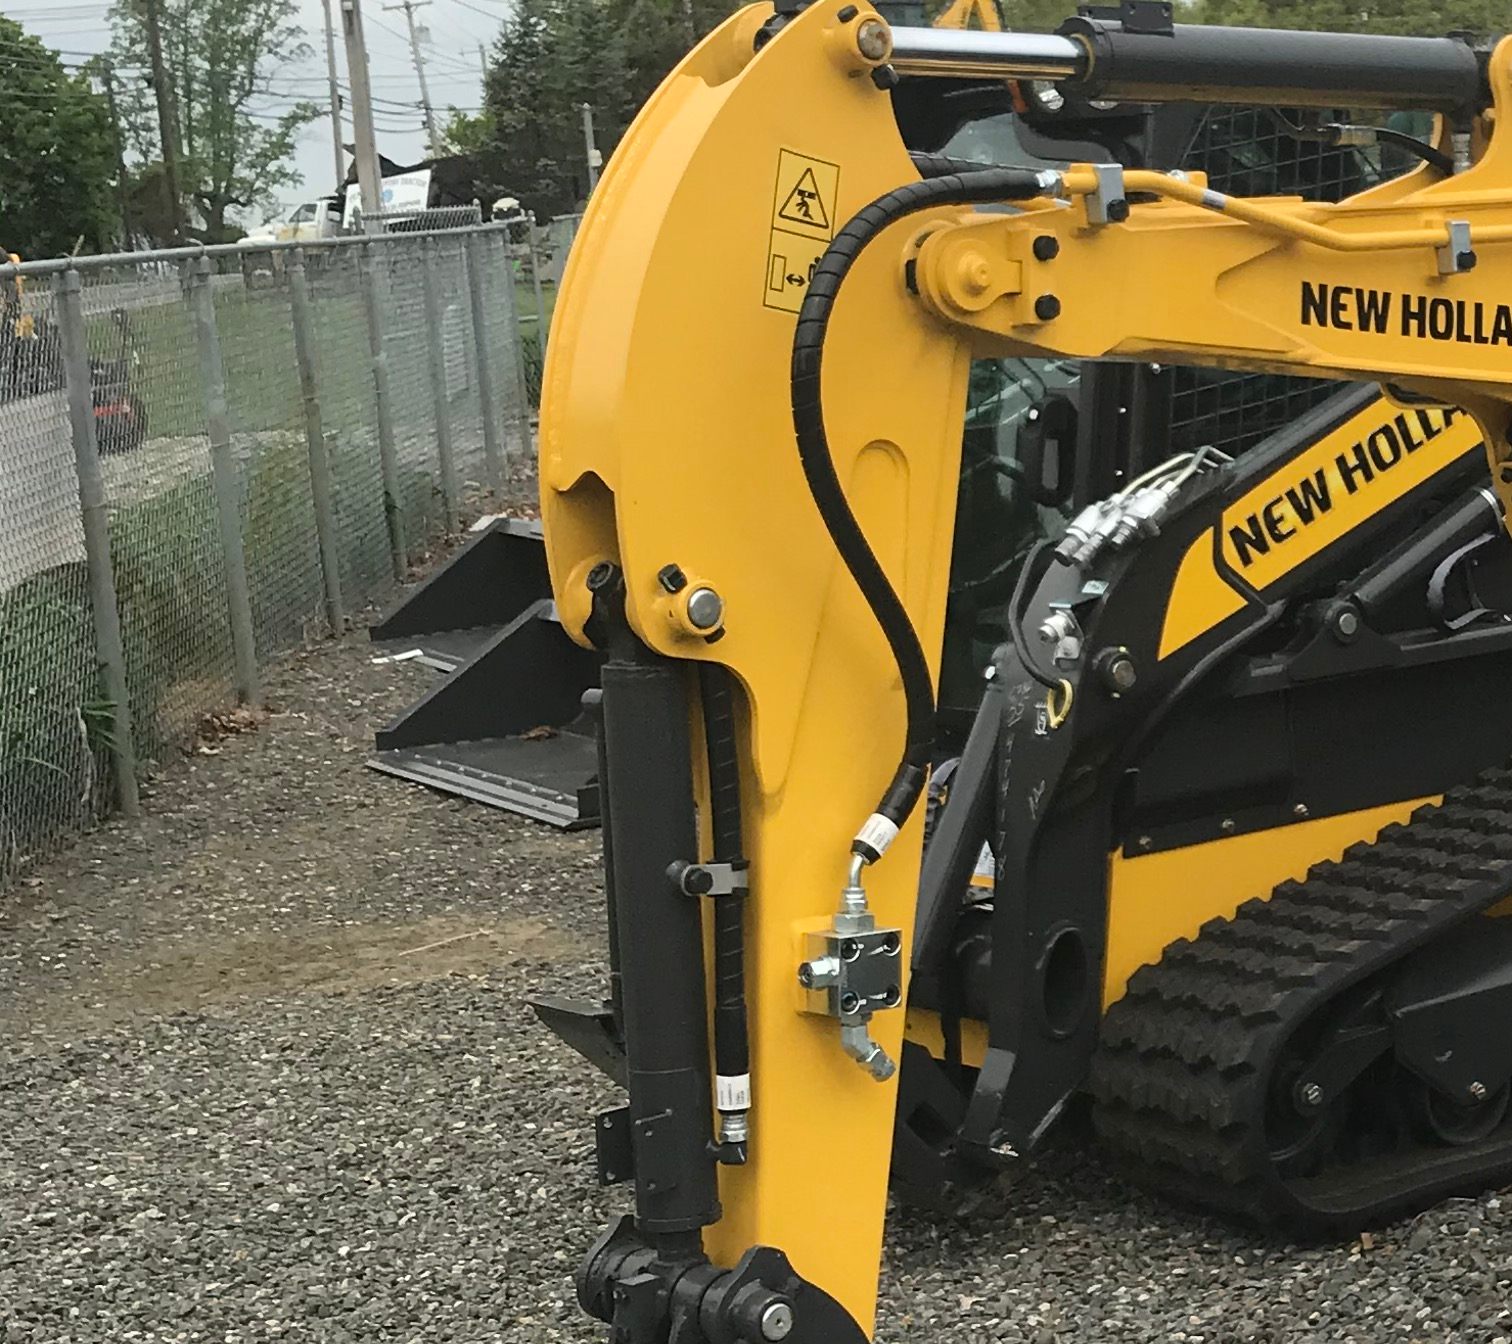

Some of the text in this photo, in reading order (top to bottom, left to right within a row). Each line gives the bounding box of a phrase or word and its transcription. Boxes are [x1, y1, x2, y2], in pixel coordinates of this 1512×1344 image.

[1301, 280, 1392, 334] NEW
[1228, 405, 1467, 568] NEW HOLL
